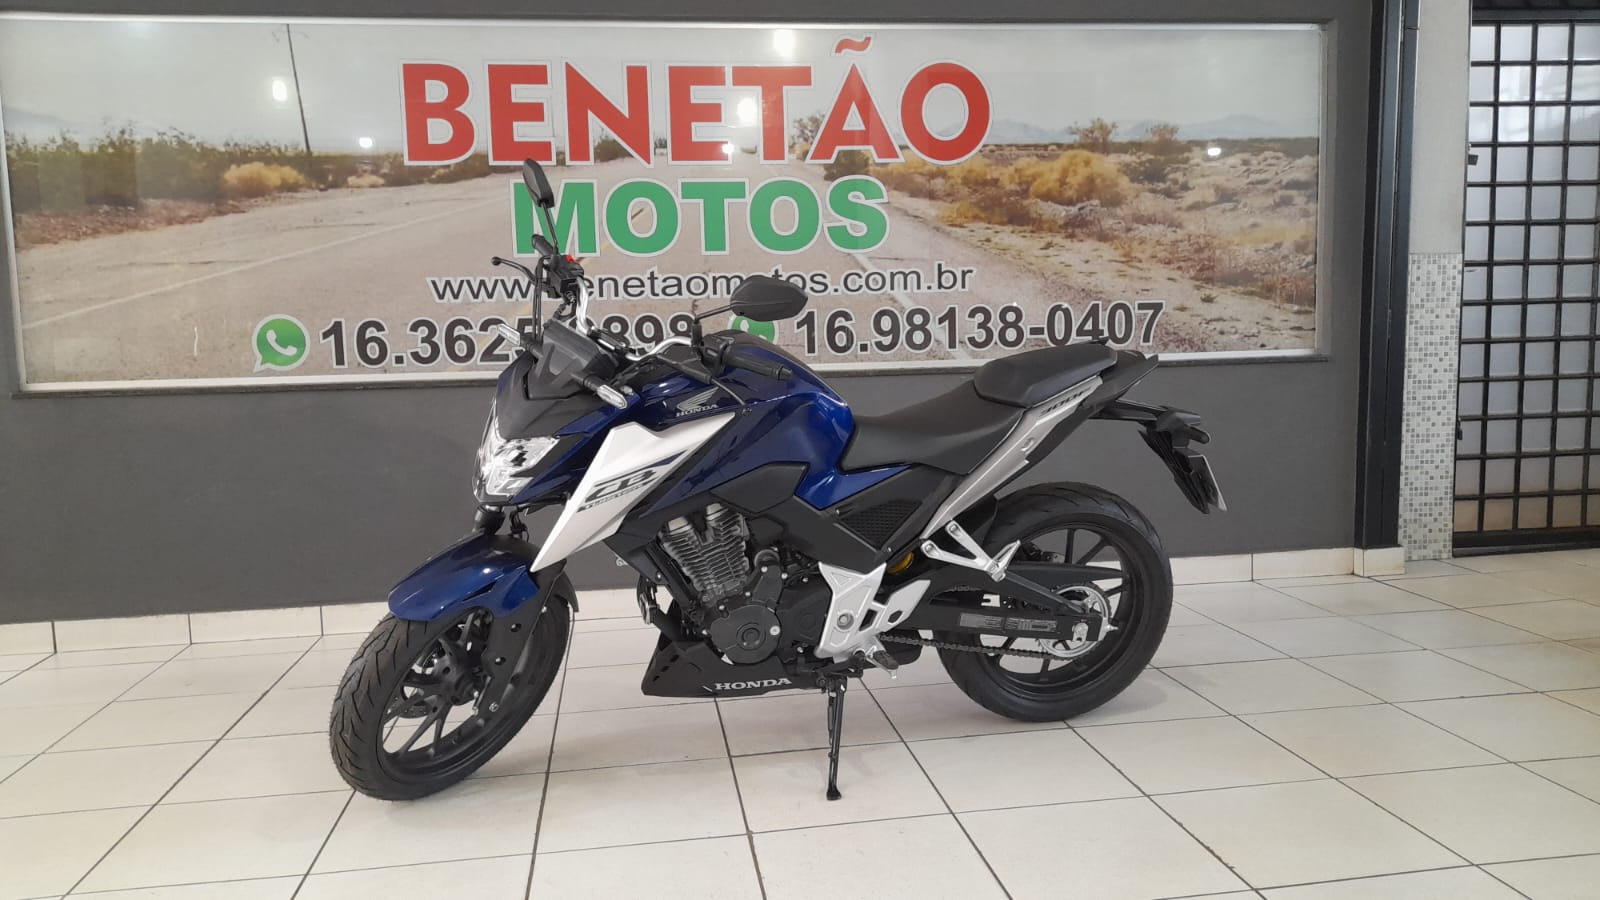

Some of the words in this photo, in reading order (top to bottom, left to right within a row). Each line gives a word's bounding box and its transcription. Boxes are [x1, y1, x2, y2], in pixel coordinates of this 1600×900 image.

[402, 36, 991, 166] BENETÃO
[513, 178, 889, 254] MOTOS
[431, 263, 974, 300] wwwenetaomos.com.br
[795, 302, 1164, 354] 16.98138-0407
[675, 404, 718, 417] HONDA
[715, 677, 792, 690] HONDA
